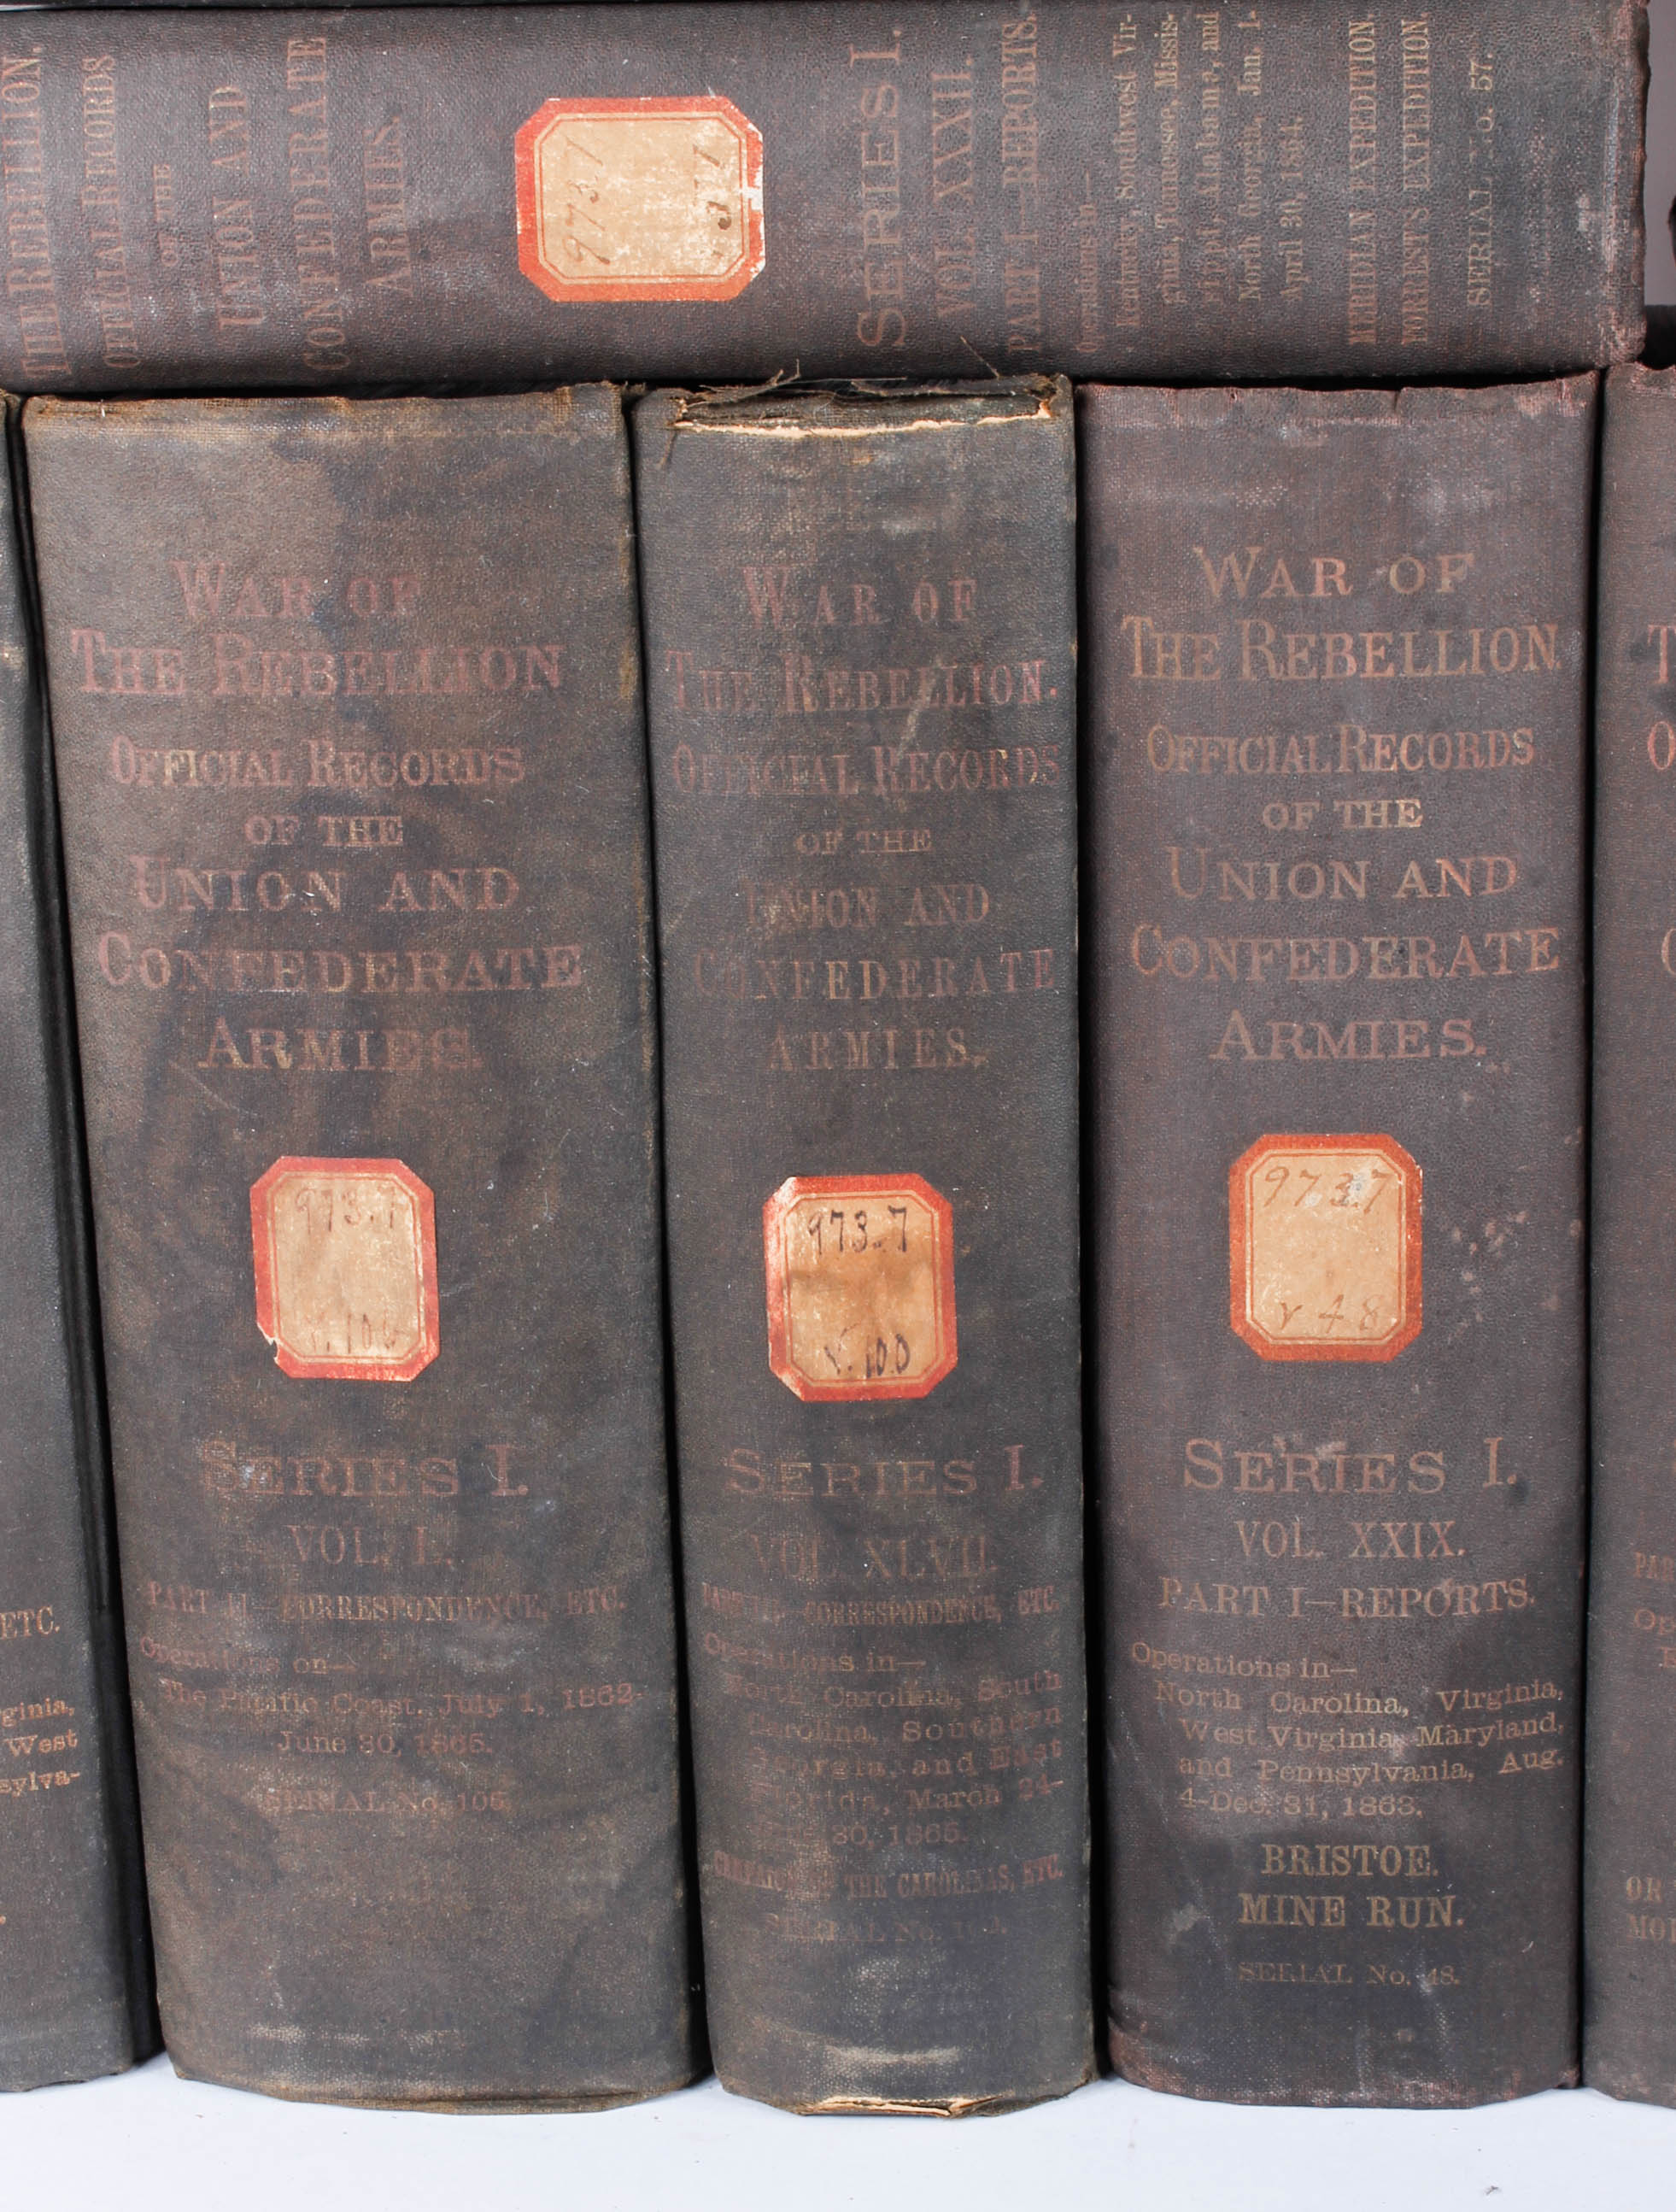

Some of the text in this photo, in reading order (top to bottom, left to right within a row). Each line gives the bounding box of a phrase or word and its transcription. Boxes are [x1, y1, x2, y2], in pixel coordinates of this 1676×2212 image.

[1111, 13, 1138, 56] Vir-
[1155, 11, 1179, 88] Missis-
[1196, 11, 1221, 50] and
[1238, 45, 1263, 95] Jan.
[1471, 52, 1493, 91] 57.
[1401, 12, 1430, 191] EXPEDITION.
[83, 54, 120, 204] RECORDS
[1113, 72, 1138, 198] Southwest
[154, 163, 172, 220] THE
[287, 36, 349, 370] CONFEDERATE
[849, 28, 906, 346] SERIES I.
[1348, 12, 1377, 344] MERIDIAN EXPEDITION.
[209, 85, 267, 329] UNION AND
[1280, 231, 1310, 300] April
[1468, 176, 1493, 306] SERIAL
[1239, 234, 1263, 301] North
[1005, 259, 1039, 353] PART
[171, 561, 421, 617] WAR OF
[741, 563, 978, 629] WAR OF
[1193, 545, 1474, 599] WAR OF
[71, 628, 565, 695] THE REBELLION
[1121, 615, 1562, 681] THE REBELLION
[665, 648, 1058, 713] THE REBELLION.
[111, 736, 525, 787] OFFICIAL RECORDS
[672, 744, 1060, 796] OFFICIAL RECORDS
[1147, 724, 1536, 773] OFFICIAL RECORDS
[244, 815, 403, 848] OF THE
[1262, 799, 1423, 830] OF THE
[795, 830, 933, 855] OF THE
[130, 855, 519, 912] UNION AND
[1165, 846, 1518, 902] UNION AND
[742, 880, 990, 930] UNION AND
[98, 930, 583, 993] CONFEDERATE
[693, 946, 1058, 1000] CONFEDERATE
[1131, 922, 1560, 981] CONFEDERATE
[769, 1024, 987, 1071] ARMIES.
[1209, 1009, 1486, 1060] ARMIES.
[200, 1440, 529, 1497] SERIES I.
[724, 1444, 1043, 1498] SERIES I.
[1183, 1436, 1517, 1495] SERIES I.
[1235, 1517, 1466, 1559] VOL. XXIX.
[147, 1581, 628, 1616] PART ETC.
[1158, 1576, 1269, 1617] PART
[1131, 1641, 1290, 1678] Operations
[159, 1677, 207, 1705] The
[439, 1692, 507, 1719] July
[520, 1692, 545, 1716] 1,
[824, 1685, 964, 1710] Carolina,
[977, 1670, 1062, 1700] South
[1156, 1678, 1563, 1718] North Carolina, Virginia,
[3, 1729, 79, 1757] West
[278, 1731, 494, 1759] June 30, 1865.
[901, 1706, 1062, 1743] Southern
[1182, 1711, 1564, 1753] West Virginia, Maryland,
[911, 1749, 976, 1776] and
[1179, 1749, 1563, 1787] and Pennsylvania, Aug.
[907, 1786, 1002, 1810] March
[1283, 1795, 1328, 1822] 31,
[1343, 1795, 1424, 1818] 1863.
[1261, 1843, 1439, 1878] BRISTOE.
[1238, 1893, 1465, 1928] MINE RUN.
[1238, 1963, 1354, 1986] SERIAL
[1366, 1963, 1413, 1987] No.
